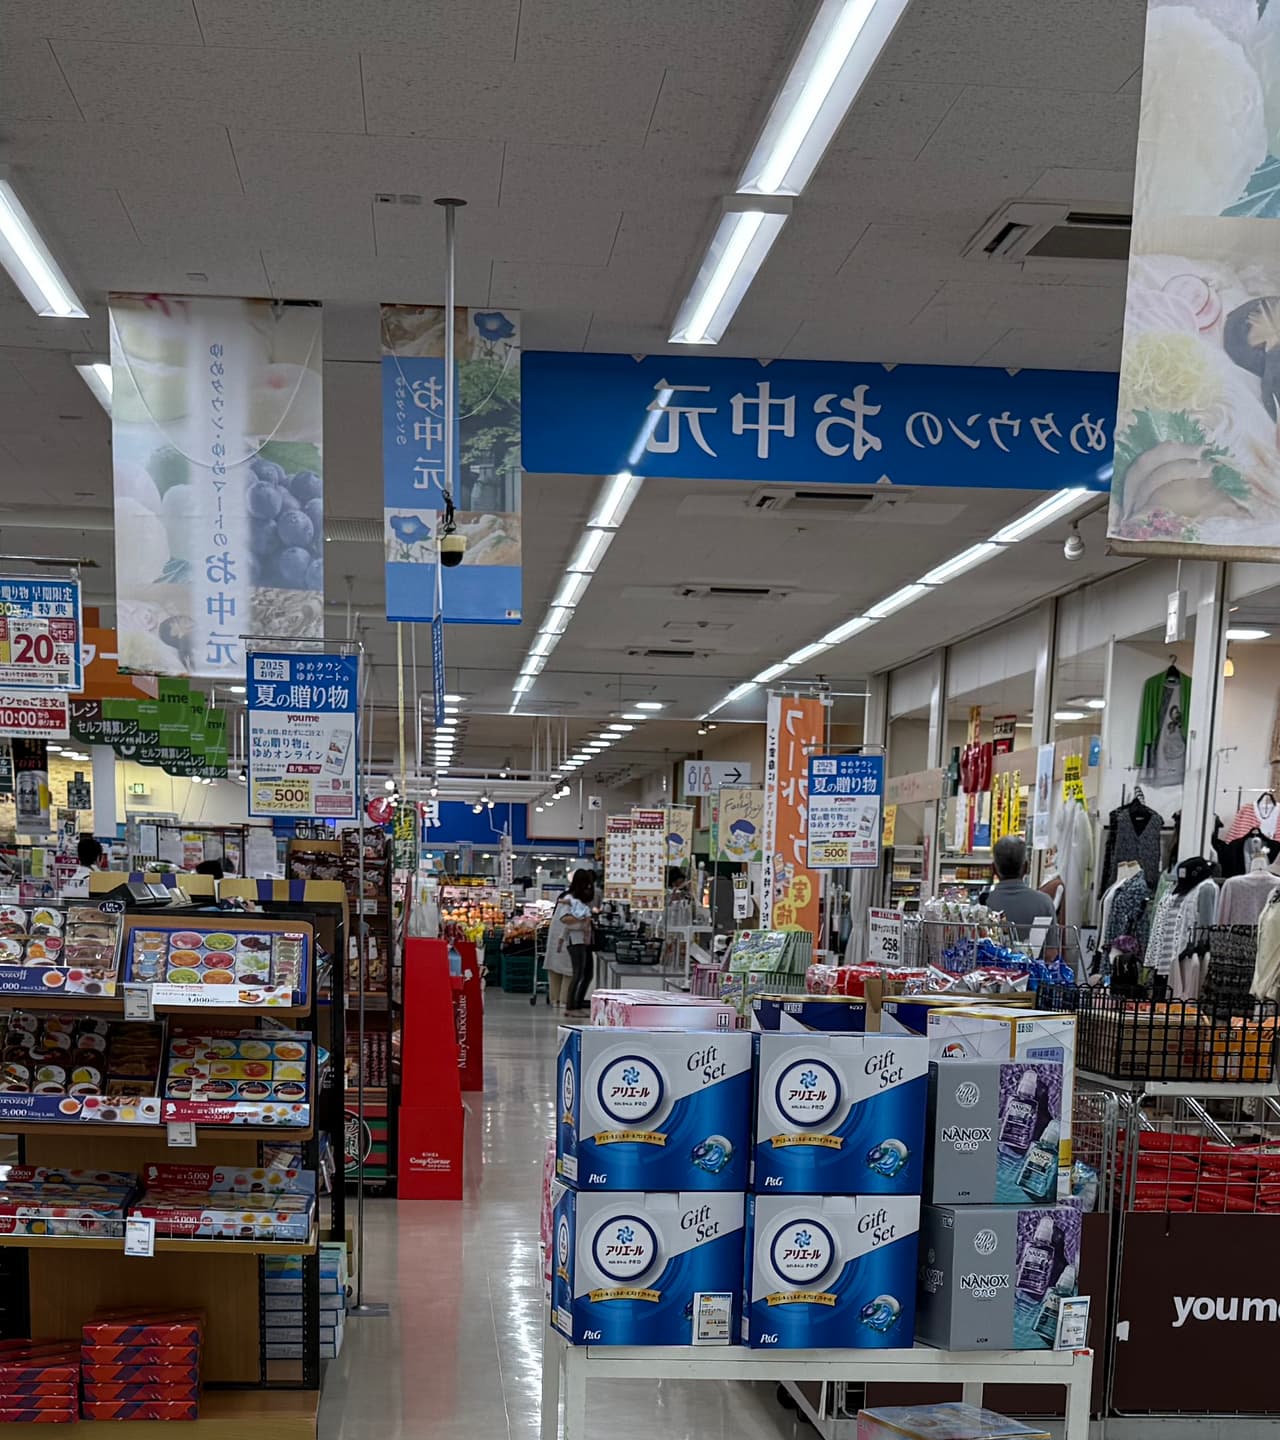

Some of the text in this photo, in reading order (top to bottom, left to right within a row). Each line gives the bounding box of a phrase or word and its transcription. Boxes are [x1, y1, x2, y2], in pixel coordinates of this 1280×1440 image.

[32, 587, 73, 601] 早期限定
[38, 603, 67, 616] 特典
[14, 634, 54, 664] 20
[260, 661, 284, 670] 2025
[296, 662, 342, 671] ゆめタウン
[254, 684, 349, 709] 夏の贈り物
[0, 710, 36, 726] 10:00
[252, 749, 324, 760] ゆめオンライン
[812, 777, 877, 793] 夏の贈り物
[687, 1046, 718, 1073] Gift
[864, 1050, 895, 1077] Gift
[703, 1064, 727, 1085] Set
[879, 1066, 904, 1089] Set
[611, 1086, 650, 1098] アリエール
[789, 1089, 827, 1102] アリエール
[942, 1127, 991, 1142] NANOX
[954, 1141, 978, 1150] one
[681, 1205, 712, 1231] Gift
[857, 1209, 888, 1234] Gift
[696, 1223, 720, 1243] Set
[872, 1226, 896, 1247] Set
[606, 1246, 644, 1257] アリエール
[784, 1249, 821, 1261] アリエール
[960, 1275, 1008, 1290] NANOX
[972, 1288, 996, 1297] one
